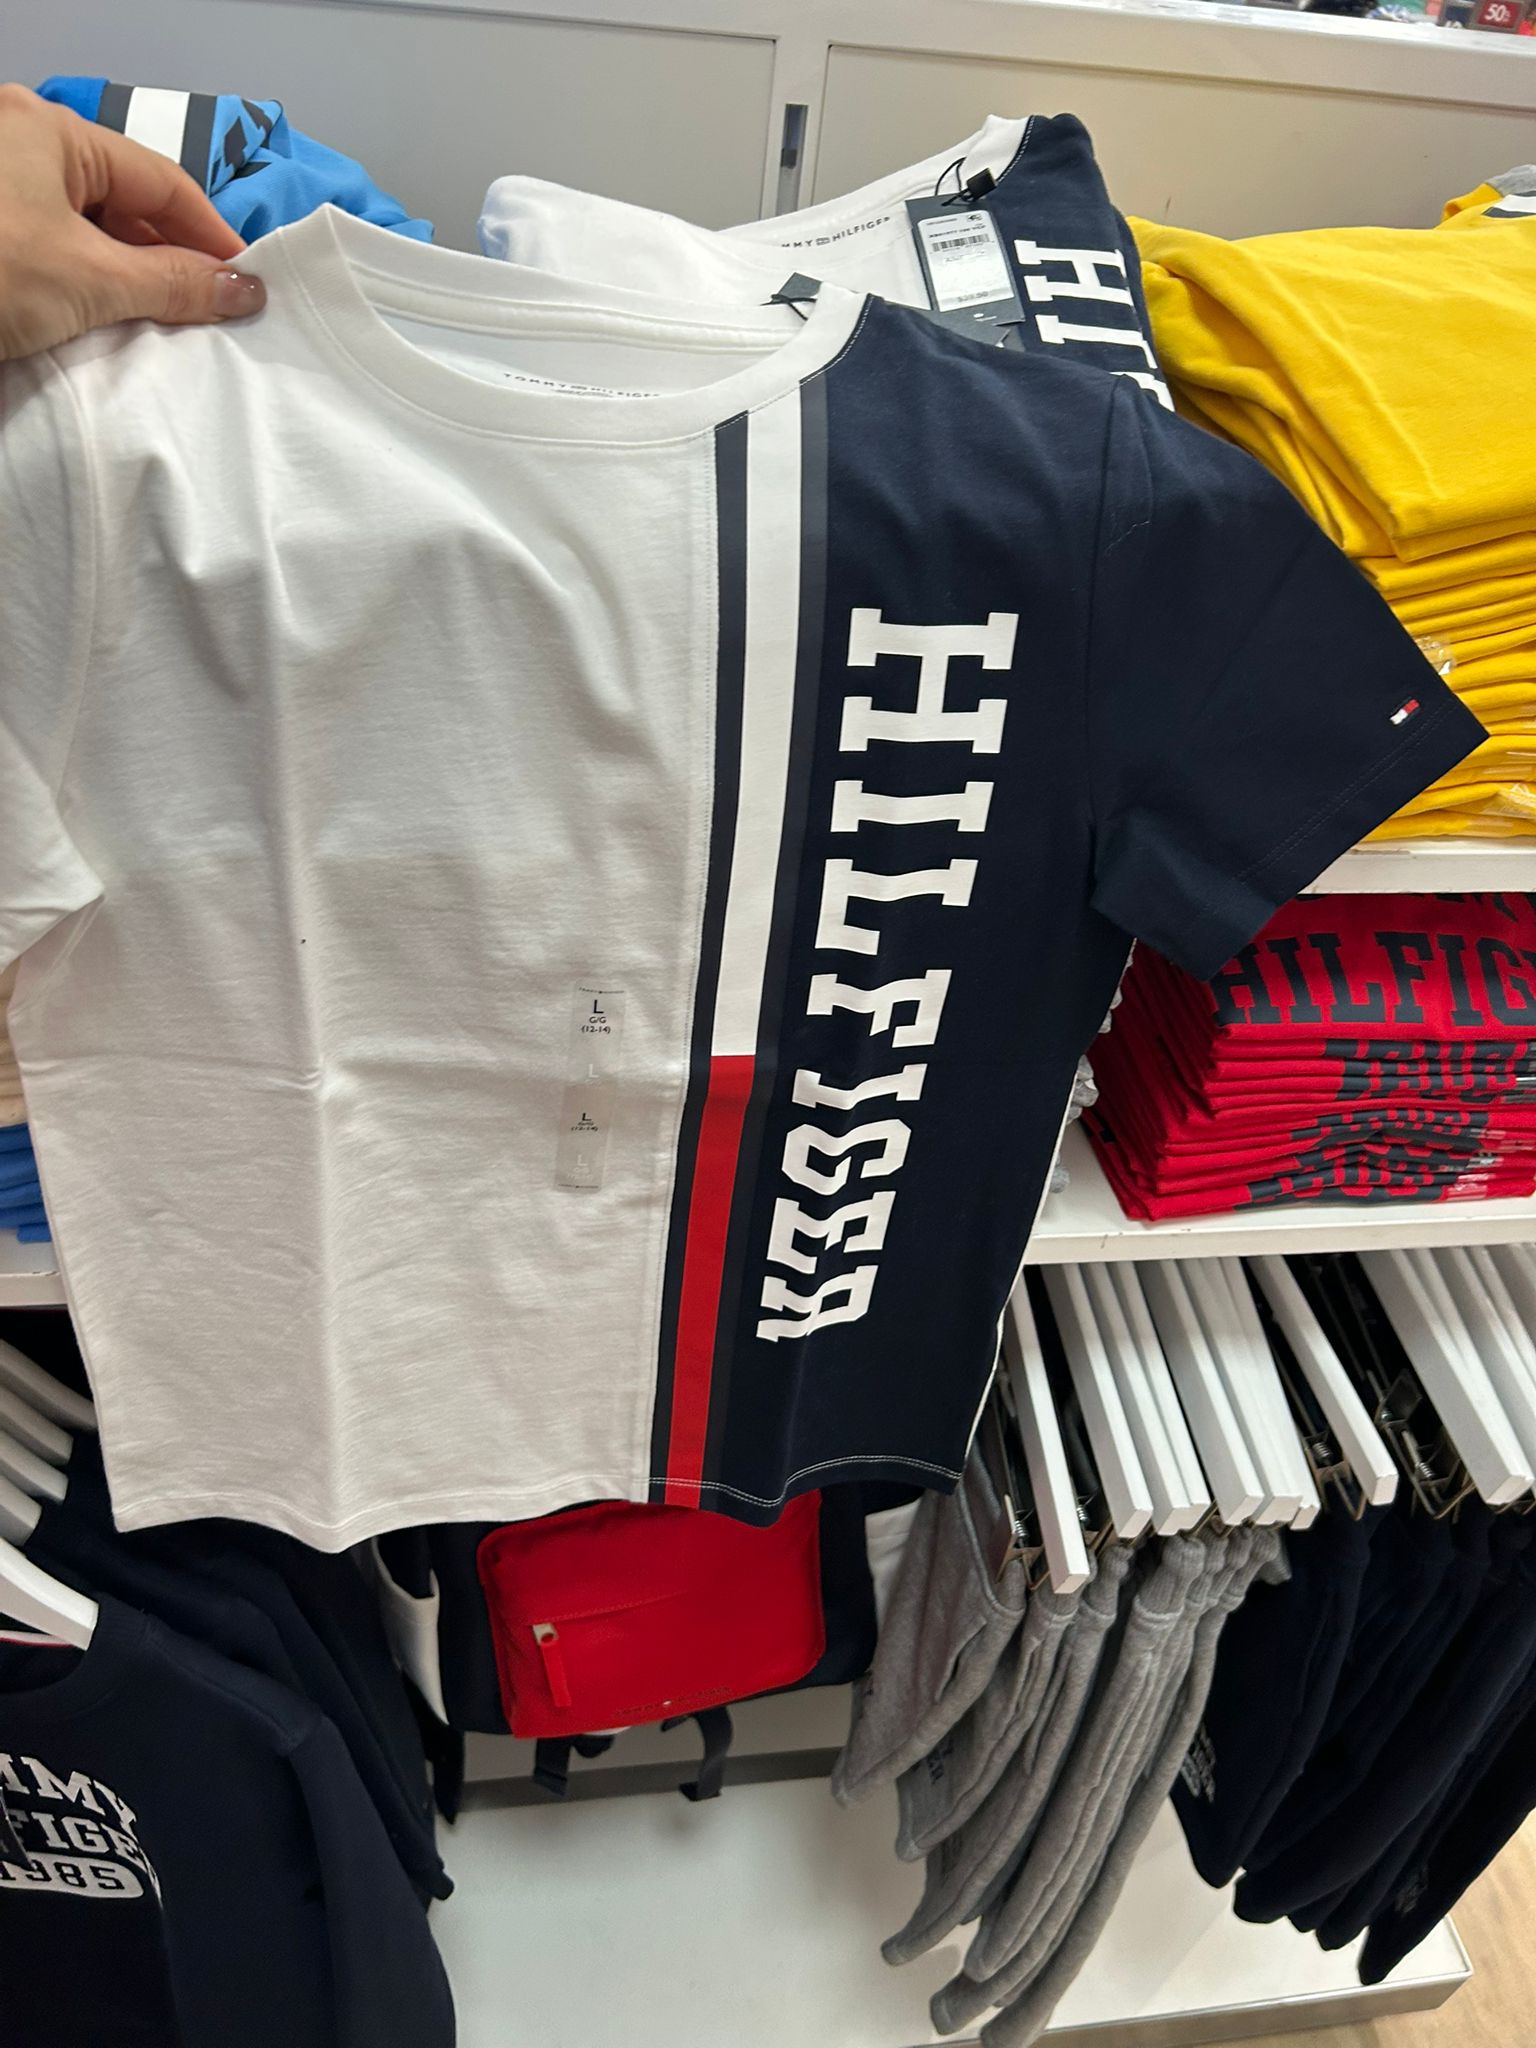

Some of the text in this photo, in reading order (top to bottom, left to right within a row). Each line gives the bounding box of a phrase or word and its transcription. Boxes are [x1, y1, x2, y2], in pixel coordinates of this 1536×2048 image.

[757, 607, 1019, 1342] HILFIGER
[1213, 931, 1536, 1027] HILFIG
[593, 999, 604, 1014] L
[589, 1016, 607, 1024] G/G
[581, 1025, 611, 1034] (12-14)
[582, 1112, 592, 1121] L
